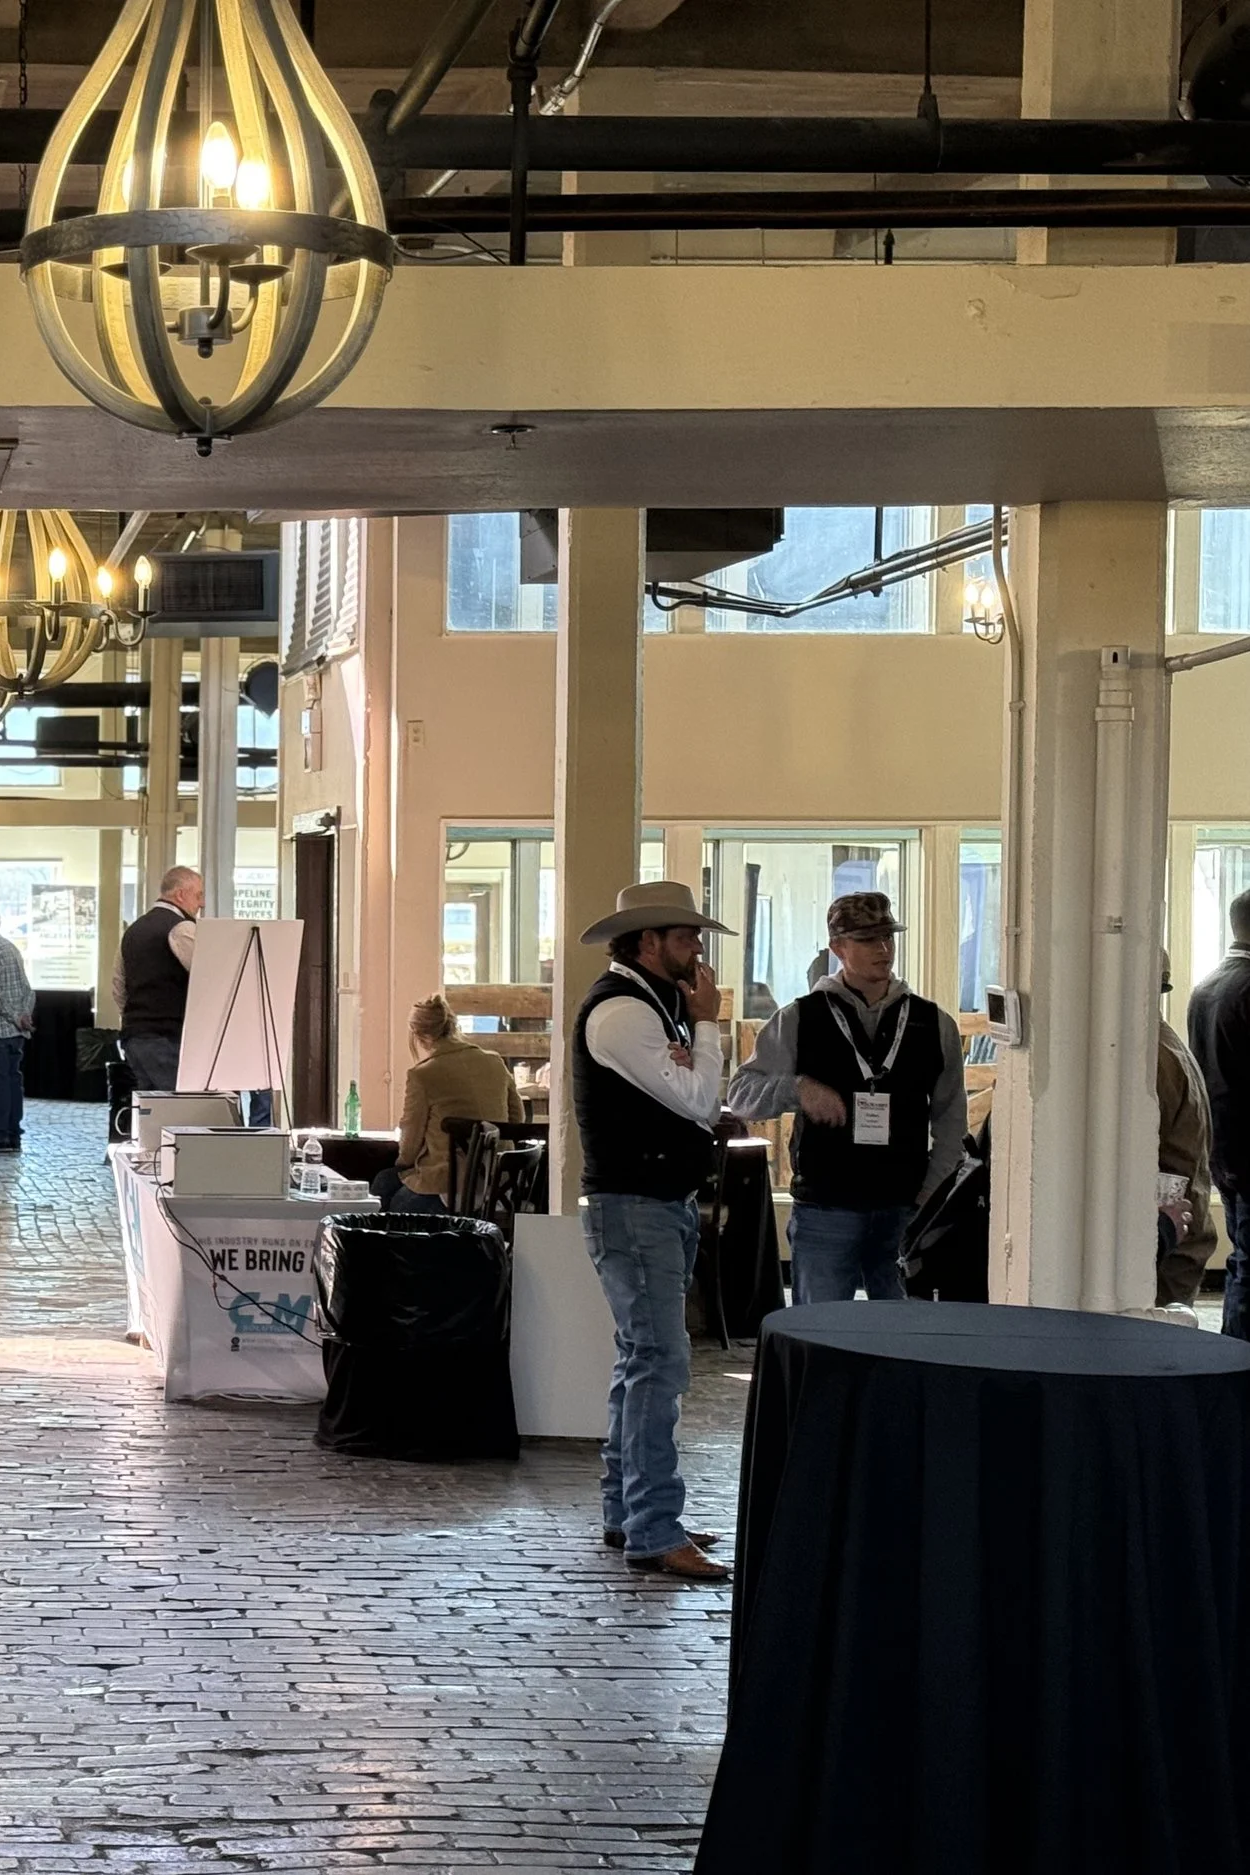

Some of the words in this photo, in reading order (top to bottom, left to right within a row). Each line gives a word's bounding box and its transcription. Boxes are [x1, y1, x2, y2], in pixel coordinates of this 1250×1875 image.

[234, 889, 272, 898] IPELINE
[235, 900, 276, 908] TEGRITY
[214, 1236, 258, 1246] INDUSTRY
[210, 1249, 239, 1271] WE
[245, 1249, 306, 1273] BRING
